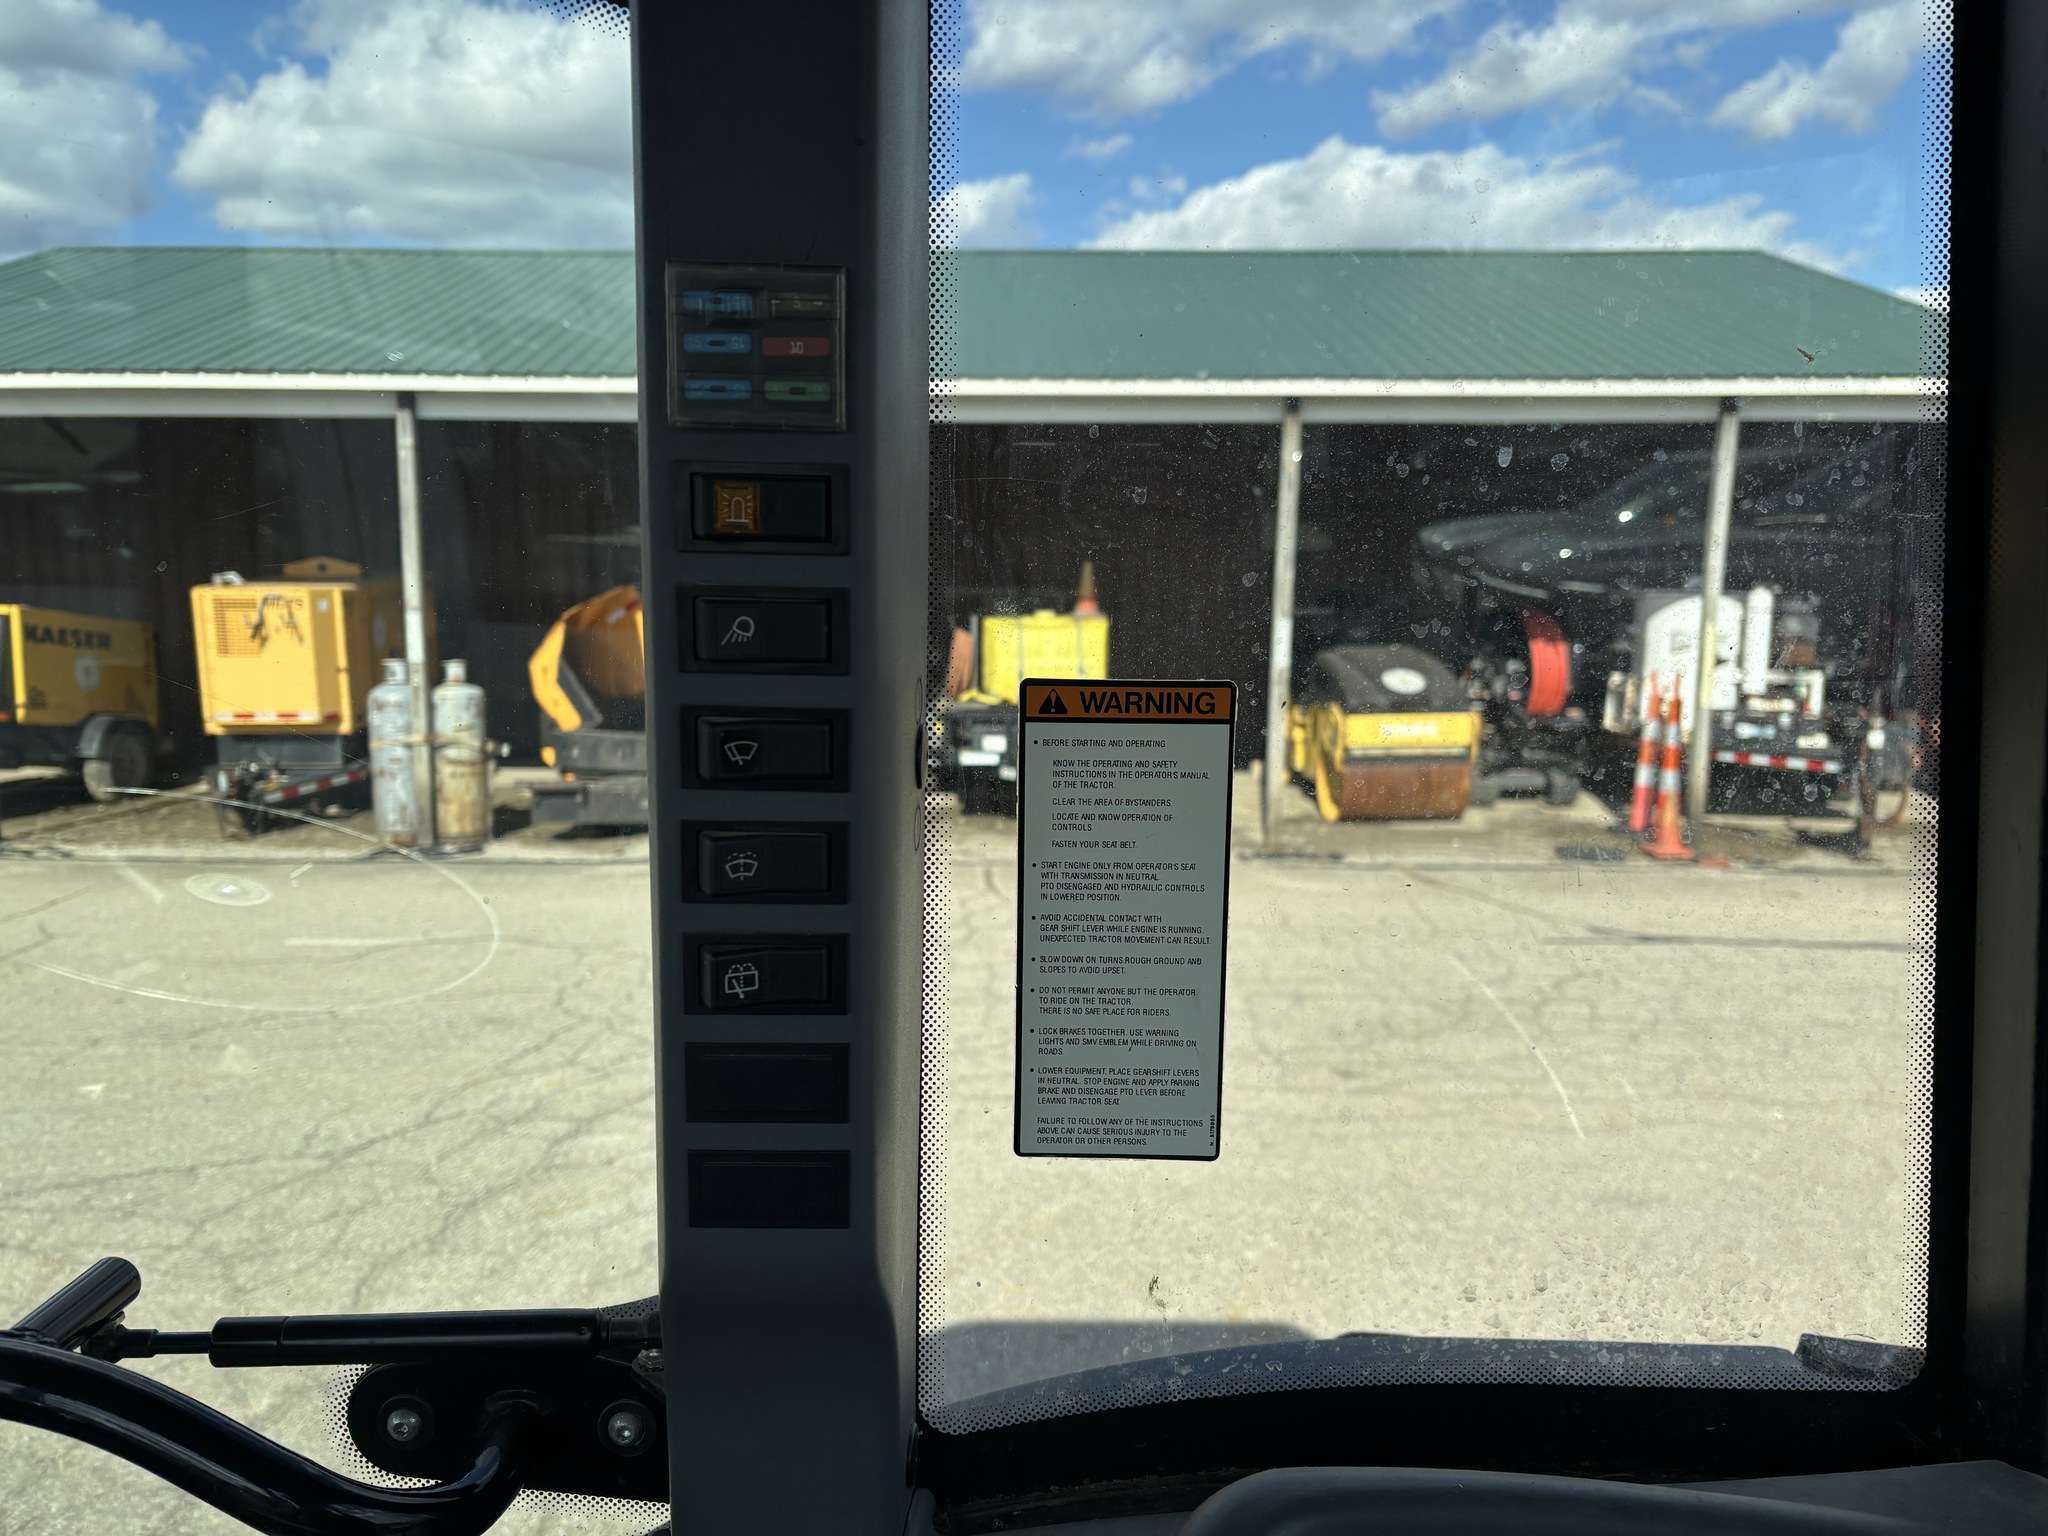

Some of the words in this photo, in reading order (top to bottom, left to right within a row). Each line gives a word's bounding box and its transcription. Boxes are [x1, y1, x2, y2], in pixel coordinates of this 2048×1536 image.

[789, 341, 804, 354] 10
[24, 623, 112, 649] KAESER
[1079, 691, 1215, 714] WARNING
[1043, 739, 1069, 747] BEFORE
[1072, 739, 1106, 747] STARTING
[1108, 740, 1123, 748] AND
[1126, 740, 1165, 748] OPERATING
[1053, 760, 1075, 768] KNOW
[1077, 760, 1090, 768] THE
[1093, 760, 1132, 768] OPERATING
[1135, 761, 1150, 769] AND
[1152, 761, 1177, 769] SAFETY
[1053, 770, 1107, 778] INSTRUCTIONS
[1109, 771, 1116, 779] IN
[1118, 771, 1132, 779] THE
[1135, 771, 1178, 779] OPERATOR'S
[1180, 772, 1209, 780] MANUAL
[1053, 781, 1062, 789] OF
[1063, 781, 1077, 789] THE
[1053, 798, 1075, 806] CLEAR
[1078, 798, 1092, 806] THE
[1094, 799, 1113, 807] AREA
[1115, 799, 1124, 807] OF
[1052, 813, 1078, 821] LOCATE
[1081, 813, 1095, 821] AND
[1098, 814, 1120, 822] KNOW
[1122, 814, 1161, 822] OPERATION
[1164, 814, 1173, 822] OF
[1052, 840, 1077, 848] FASTEN
[1079, 841, 1099, 849] YOUR
[1102, 841, 1118, 849] SEAT
[1041, 861, 1062, 869] START
[1064, 862, 1090, 870] ENGINE
[1093, 862, 1111, 870] ONLY
[1113, 862, 1133, 870] FROM
[1136, 863, 1179, 871] OPERATOR'S
[1181, 863, 1196, 871] SEAT
[1041, 872, 1058, 880] WITH
[1061, 872, 1114, 880] TRANSMISSION
[1116, 873, 1123, 881] IN
[1041, 882, 1054, 890] PTO
[1057, 883, 1102, 891] DISENGAGED
[1104, 883, 1119, 891] AND
[1121, 884, 1162, 892] HYDRAULIC
[1165, 884, 1205, 892] CONTROLS
[1041, 893, 1047, 901] IN
[1050, 893, 1084, 901] LOWERED
[1040, 914, 1061, 922] AVOID
[1063, 914, 1106, 922] ACCIDENTAL
[1109, 915, 1142, 923] CONTACT
[1144, 915, 1161, 923] WITH
[1040, 924, 1058, 932] GEAR
[1082, 925, 1104, 933] LEVER
[1106, 925, 1129, 933] WHILE
[1131, 925, 1157, 933] ENGINE
[1160, 926, 1166, 934] IS
[1040, 935, 1086, 943] UNEXPECTED
[1088, 935, 1122, 943] TRACTOR
[1124, 936, 1165, 944] MOVEMENT
[1167, 937, 1181, 945] CAN
[1040, 956, 1060, 964] SLOW
[1062, 956, 1083, 964] DOWN
[1086, 956, 1096, 964] ON
[1125, 957, 1151, 965] ROUGH
[1154, 957, 1185, 965] GROUND
[1187, 958, 1202, 966] AND
[1040, 965, 1066, 973] SLOPES
[1068, 966, 1077, 974] TO
[1079, 966, 1100, 974] AVOID
[1039, 987, 1049, 995] DO
[1052, 987, 1066, 995] NOT
[1068, 987, 1094, 995] PERMIT
[1097, 988, 1125, 996] ANYONE
[1128, 988, 1141, 996] BUT
[1144, 988, 1156, 996] THE
[1159, 989, 1195, 997] OPERATOR
[1039, 997, 1048, 1005] TO
[1051, 997, 1067, 1005] RIDE
[1069, 997, 1079, 1005] ON
[1082, 997, 1095, 1005] THE
[1039, 1007, 1061, 1015] THERE
[1064, 1007, 1070, 1015] IS
[1085, 1008, 1100, 1016] SAFE
[1103, 1008, 1125, 1016] PLACE
[1127, 1008, 1140, 1016] FOR
[1039, 1028, 1058, 1036] LOCK
[1059, 1028, 1086, 1036] BRAKES
[1130, 1029, 1143, 1037] USE
[1039, 1038, 1064, 1046] LIGHTS
[1065, 1038, 1080, 1046] AND
[1082, 1038, 1097, 1046] SMV
[1099, 1039, 1128, 1047] EMBLEM
[1131, 1039, 1152, 1047] WHILE
[1155, 1040, 1184, 1048] DRIVING
[1186, 1040, 1196, 1048] ON
[1038, 1067, 1062, 1075] LOWER
[1109, 1068, 1131, 1076] PLACE
[1133, 1068, 1171, 1076] GEARSHIFT
[1173, 1069, 1199, 1077] LEVERS
[1038, 1077, 1045, 1085] IN
[1084, 1078, 1102, 1086] STOP
[1103, 1078, 1129, 1086] ENGINE
[1132, 1079, 1146, 1087] AND
[1148, 1079, 1169, 1087] APPLY
[1171, 1079, 1199, 1087] PARKING
[1038, 1087, 1059, 1095] BRAKE
[1078, 1088, 1117, 1096] DISENGAGE
[1120, 1088, 1133, 1096] PTO
[1136, 1089, 1157, 1097] LEVER
[1160, 1089, 1185, 1097] BEFORE
[1038, 1097, 1066, 1105] LEAVING
[1069, 1098, 1102, 1106] TRACTOR
[1037, 1117, 1065, 1125] FAILURE
[1079, 1118, 1107, 1126] FOLLOW
[1125, 1118, 1133, 1126] OF
[1135, 1118, 1148, 1126] THE
[1151, 1119, 1203, 1127] INSTRUCTIONS
[1037, 1127, 1058, 1135] ABOVE
[1061, 1127, 1075, 1135] CAN
[1078, 1128, 1100, 1136] CAUSE
[1103, 1128, 1133, 1136] SERIOUS
[1135, 1129, 1160, 1137] INJURY
[1162, 1129, 1171, 1137] TO
[1174, 1129, 1187, 1137] THE
[1037, 1137, 1072, 1145] OPERATOR
[1075, 1137, 1085, 1145] OR
